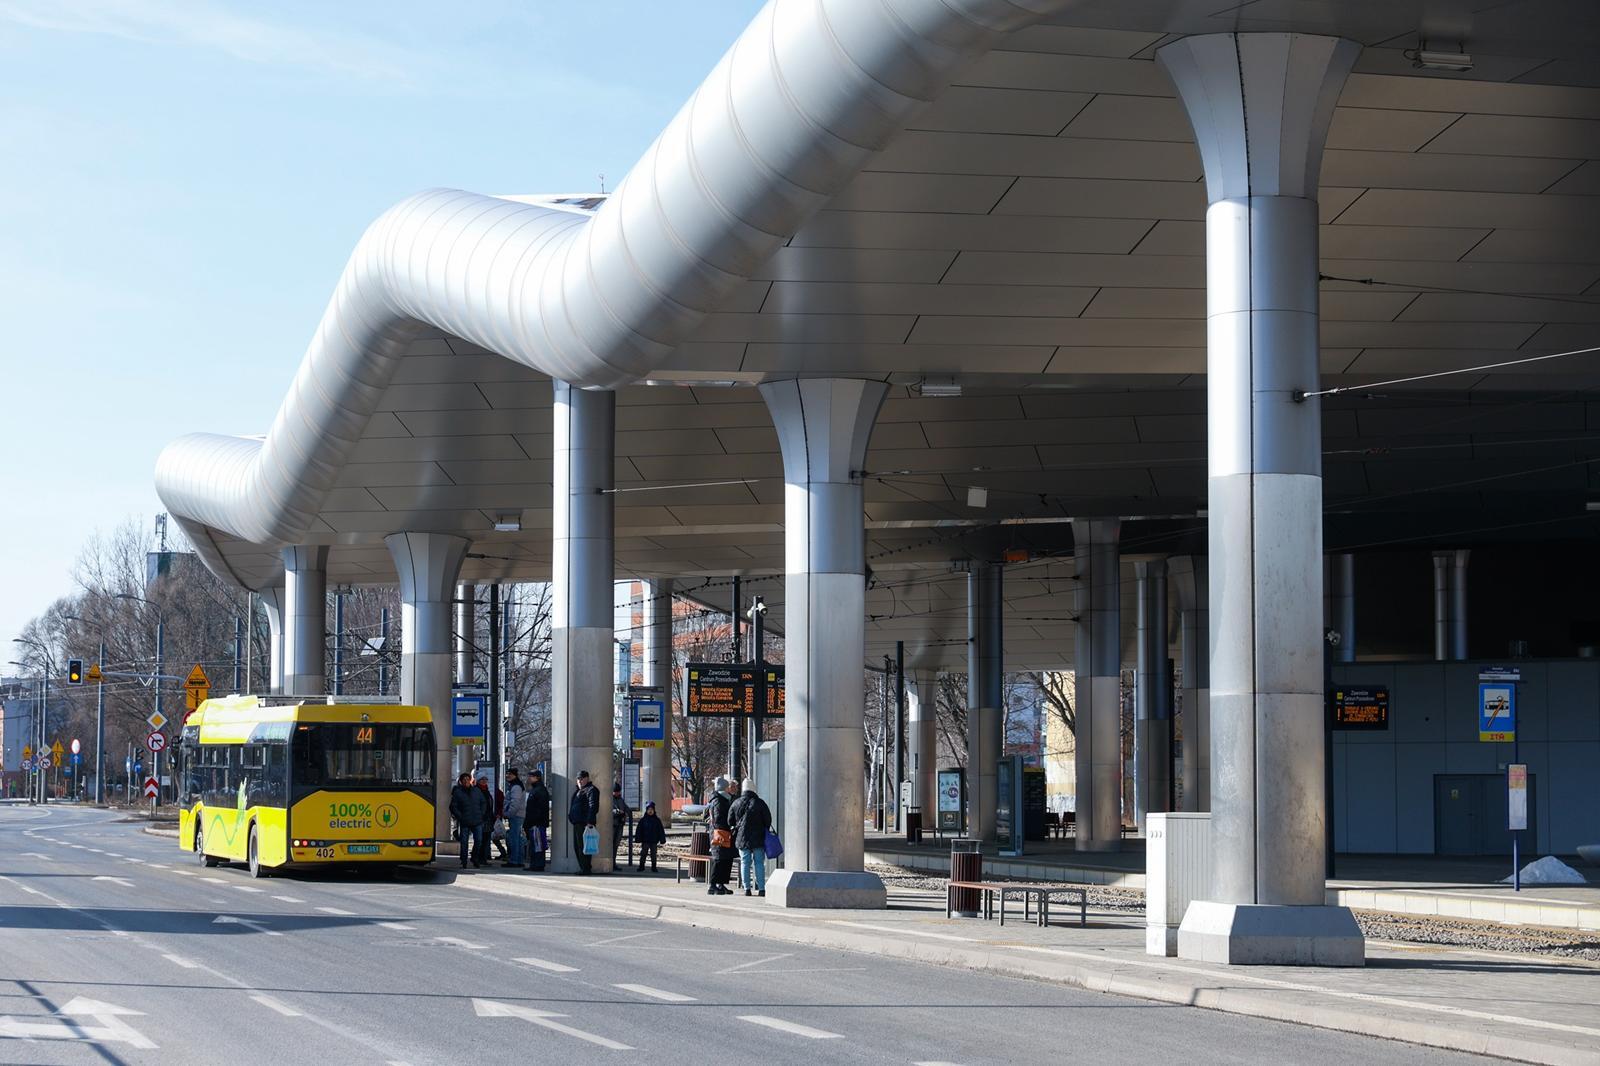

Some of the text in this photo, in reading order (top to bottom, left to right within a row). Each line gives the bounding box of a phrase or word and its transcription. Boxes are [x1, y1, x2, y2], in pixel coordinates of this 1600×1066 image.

[357, 727, 373, 744] 44
[329, 803, 372, 817] 100%
[329, 818, 372, 829] electric
[316, 848, 335, 858] 402
